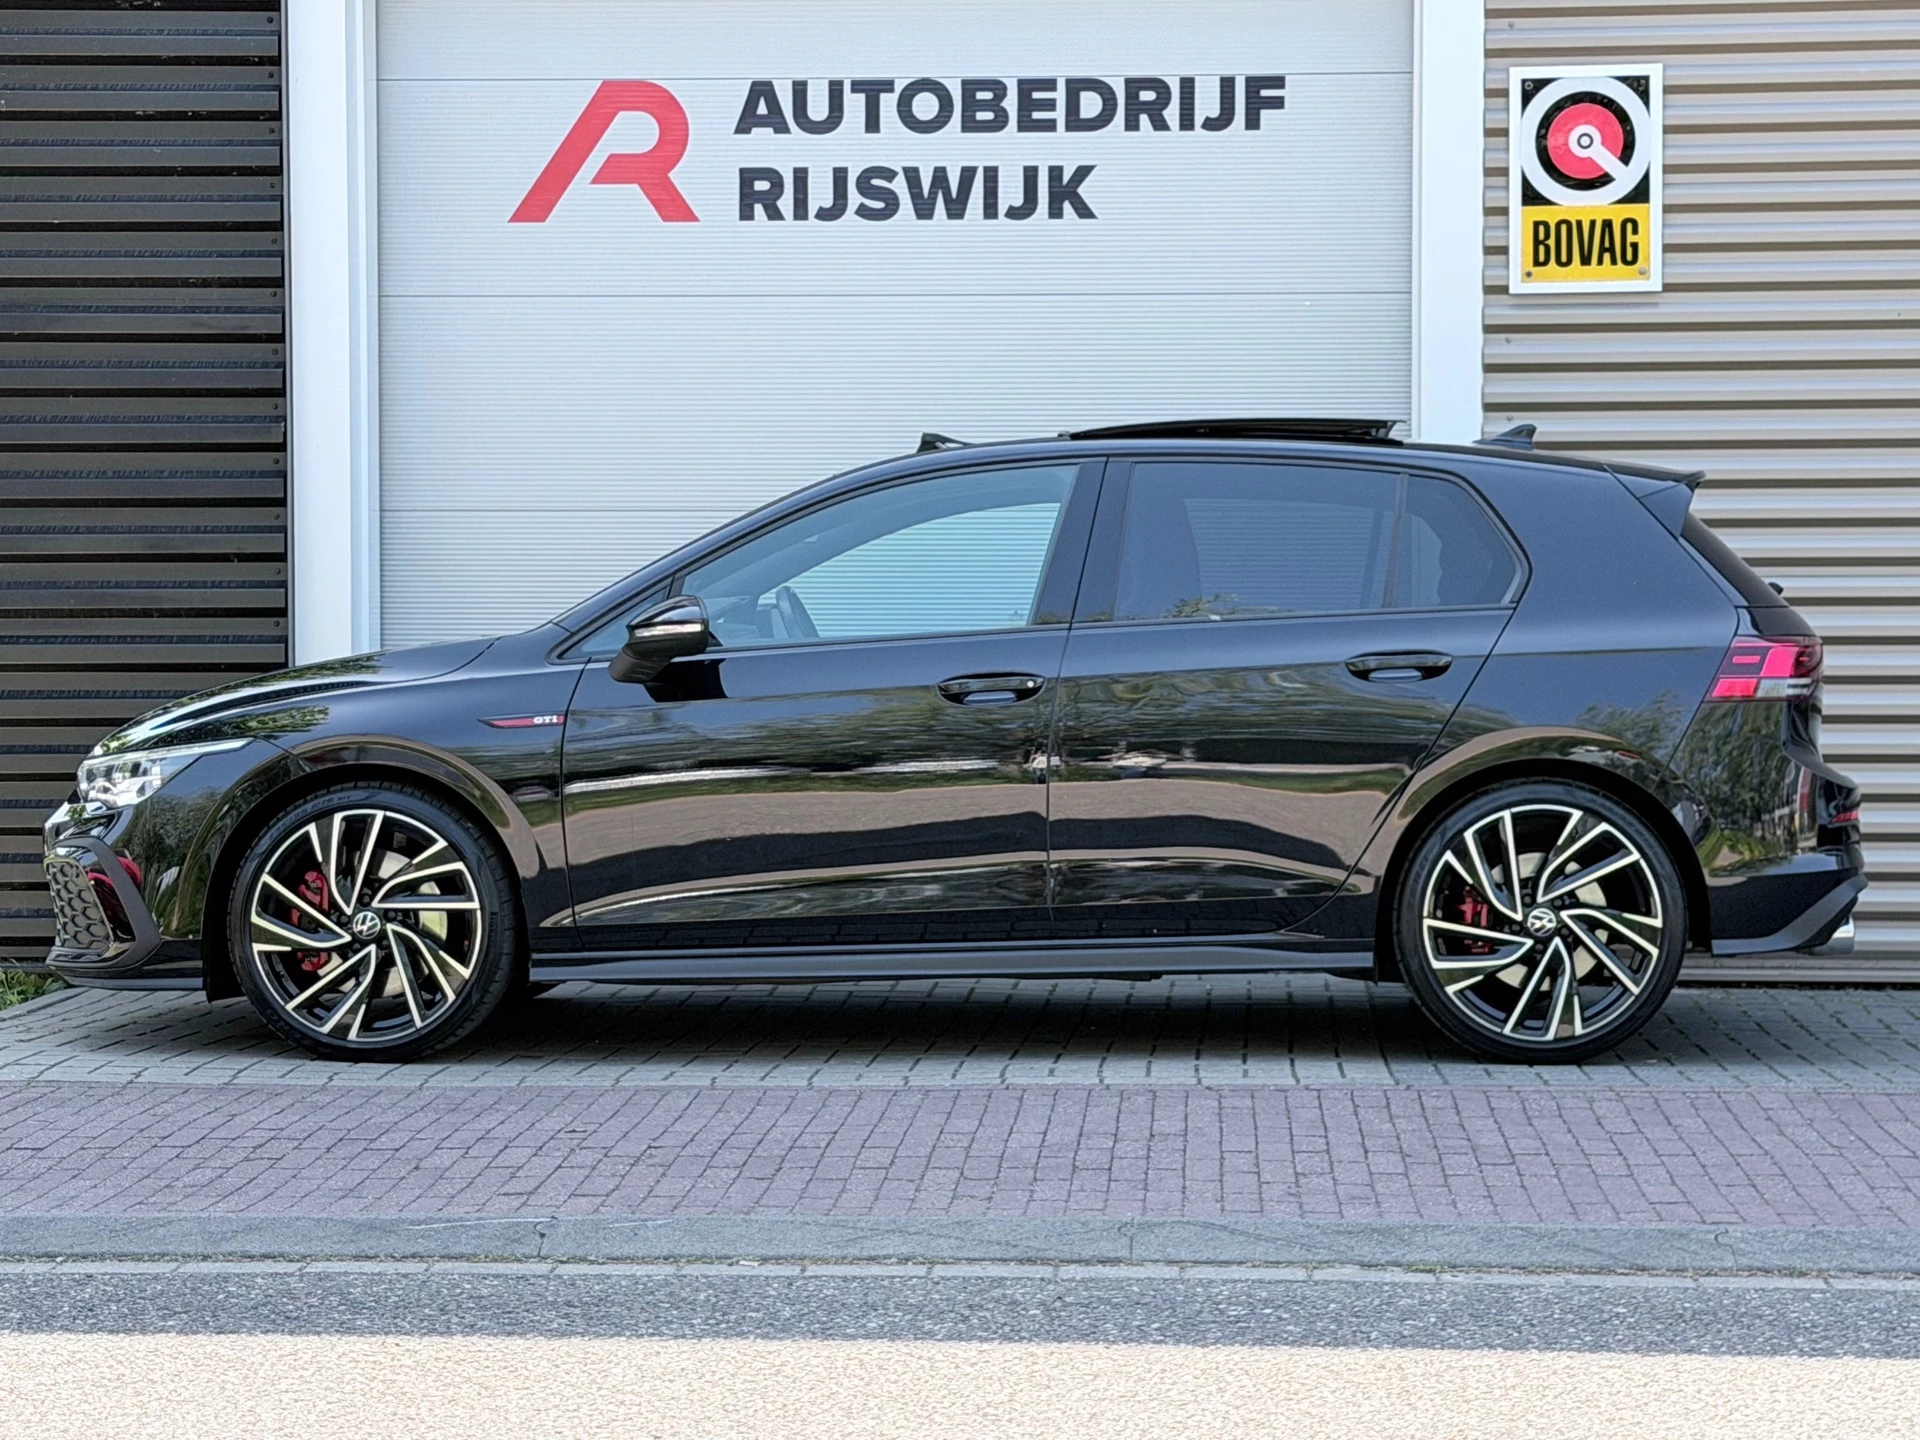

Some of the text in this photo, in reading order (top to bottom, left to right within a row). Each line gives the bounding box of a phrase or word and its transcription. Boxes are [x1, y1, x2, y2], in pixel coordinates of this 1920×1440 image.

[733, 75, 1287, 135] AUTOBEDRIJF
[737, 164, 1099, 222] RIJSWIJK
[1532, 217, 1640, 268] BOVAG
[533, 715, 558, 724] GTI
